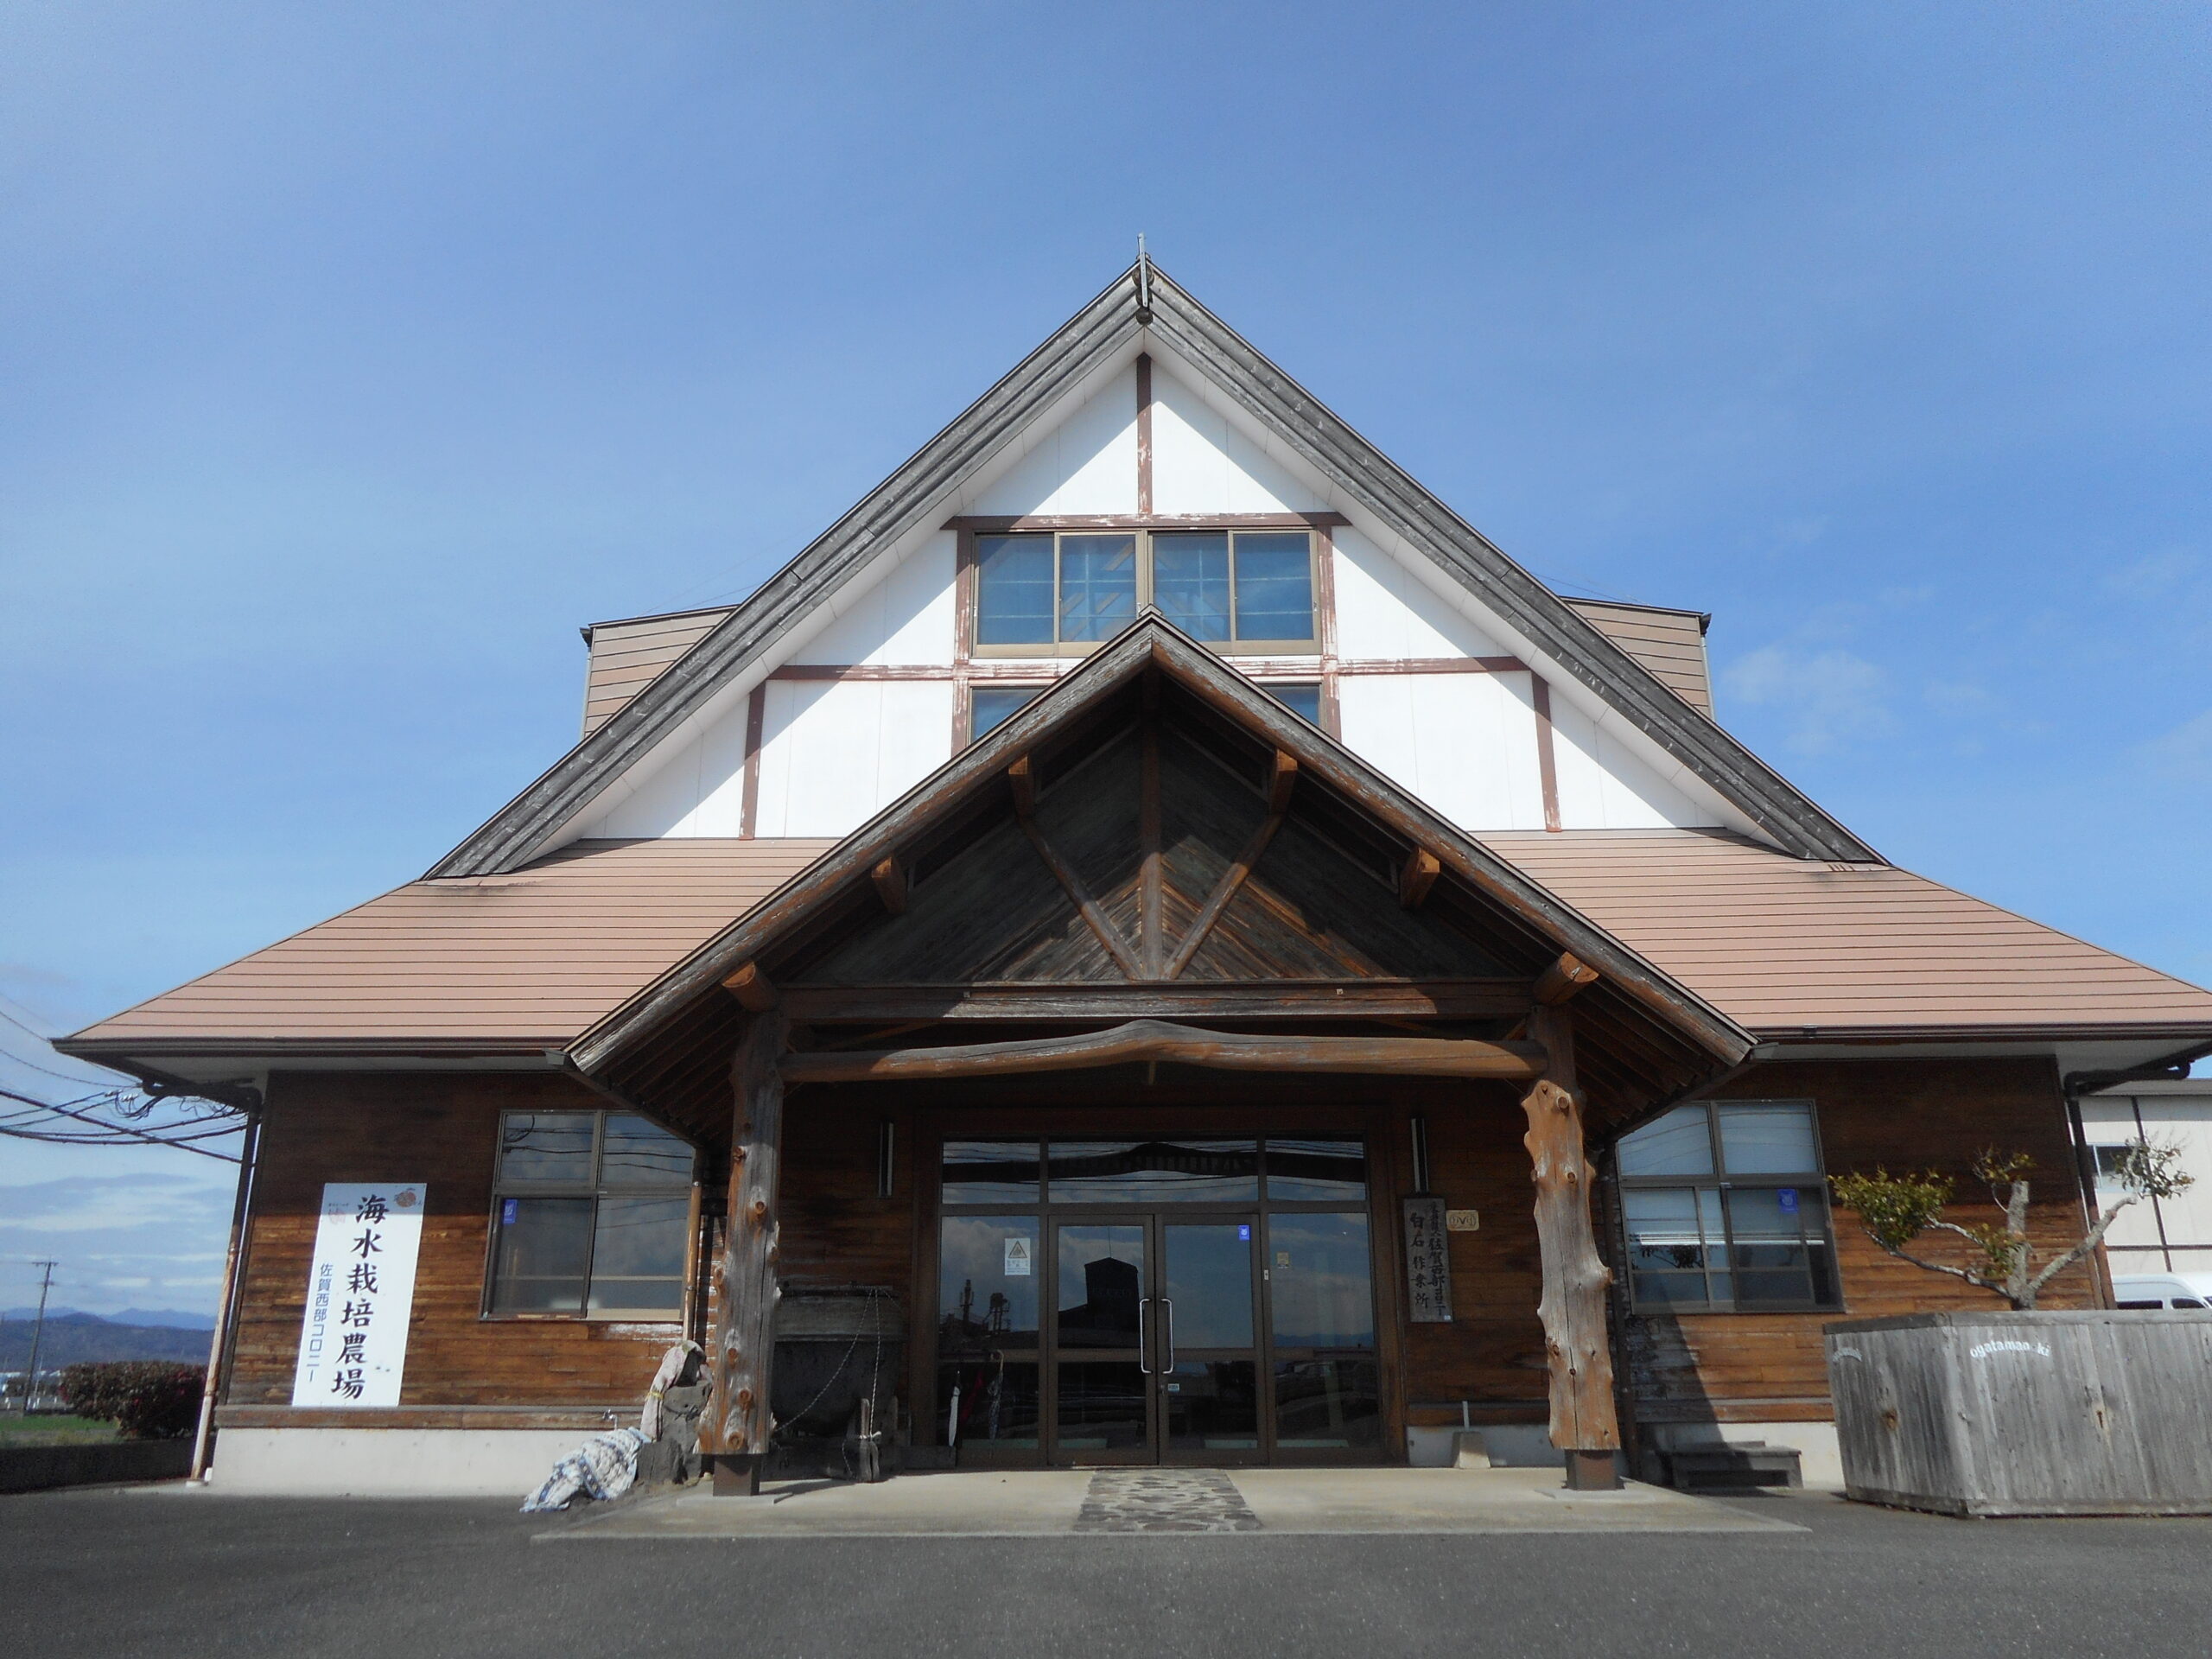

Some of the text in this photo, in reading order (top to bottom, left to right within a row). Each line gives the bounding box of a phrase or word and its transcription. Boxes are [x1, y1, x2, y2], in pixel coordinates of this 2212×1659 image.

[306, 1262, 334, 1382] 佐賀西部コロニー
[331, 1194, 389, 1400] 海水栽培農場
